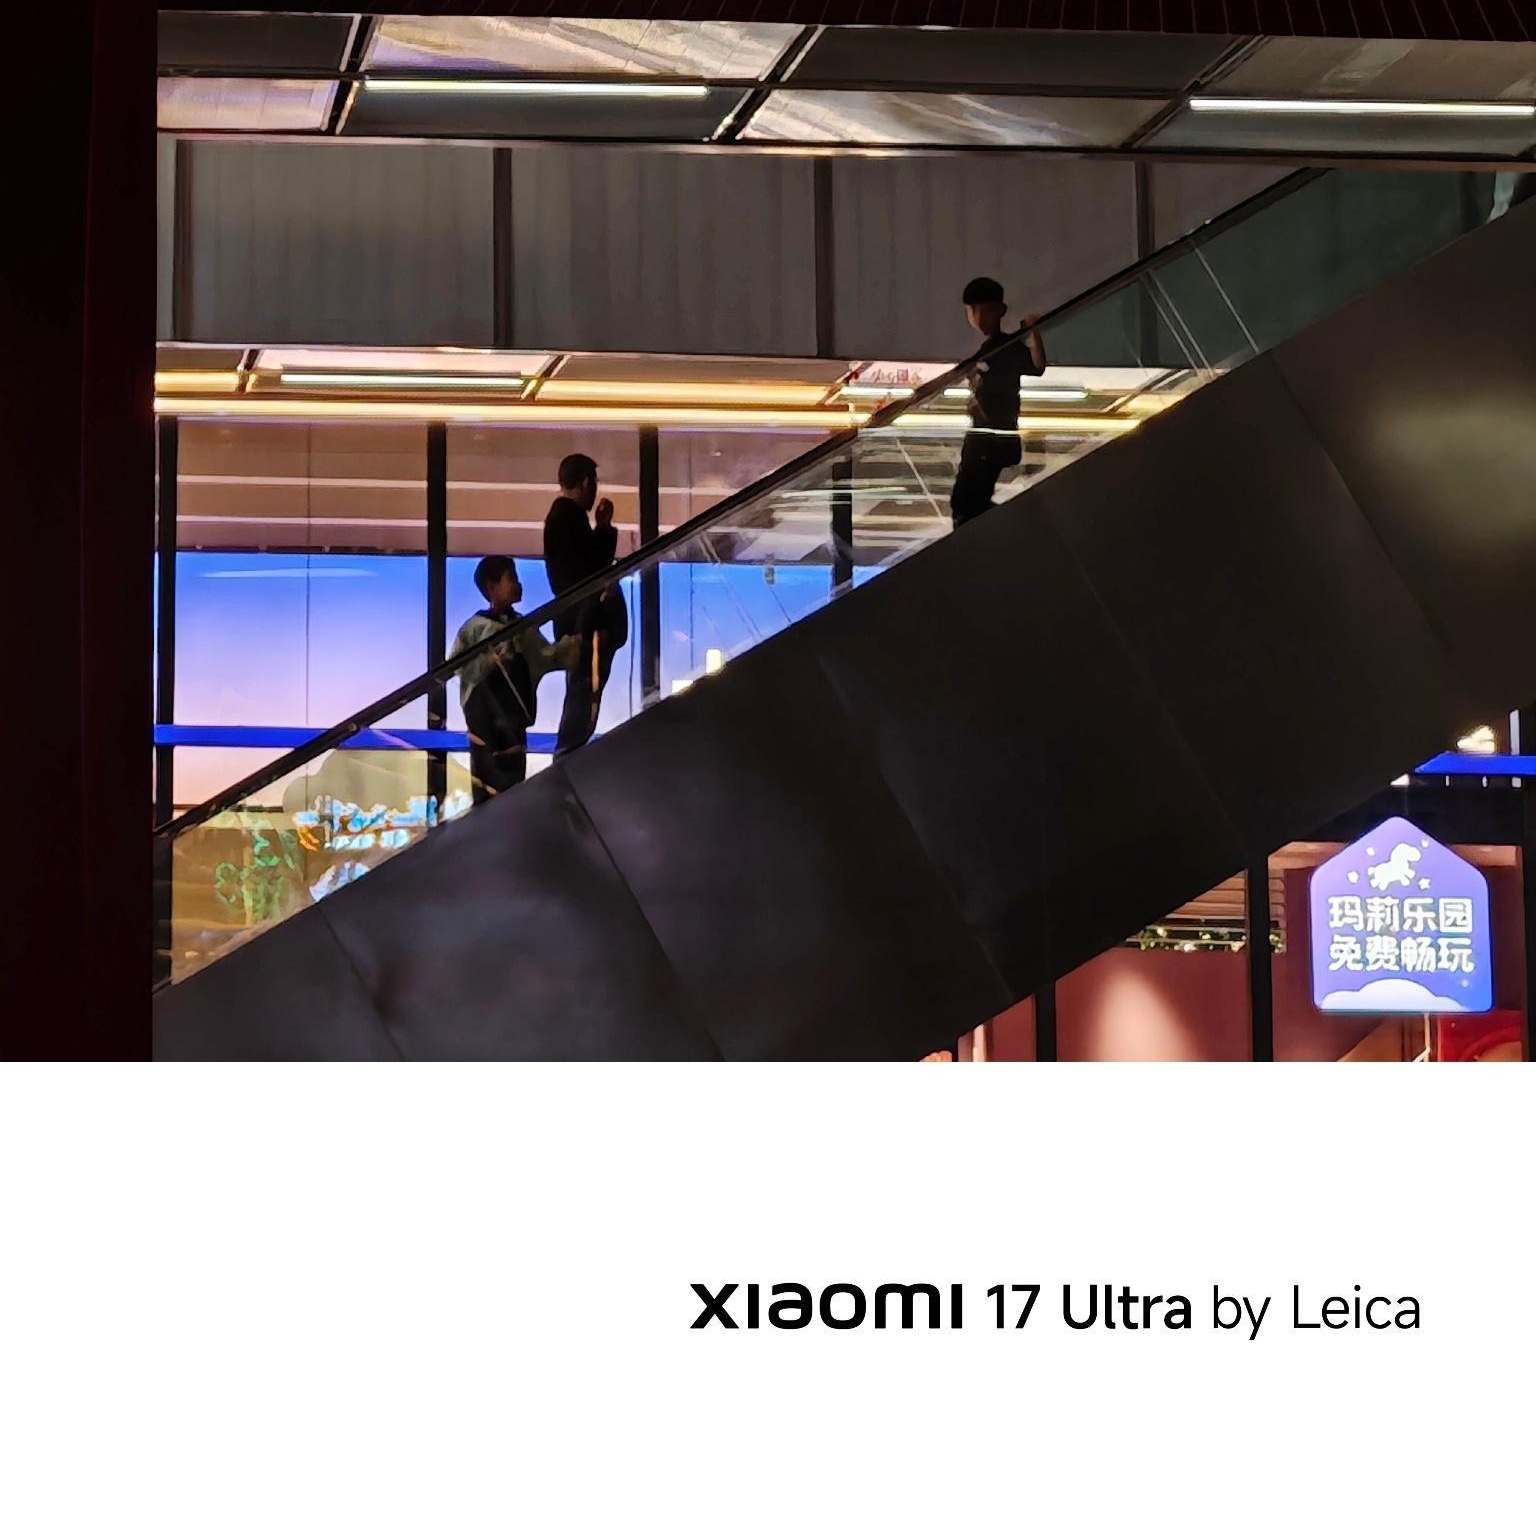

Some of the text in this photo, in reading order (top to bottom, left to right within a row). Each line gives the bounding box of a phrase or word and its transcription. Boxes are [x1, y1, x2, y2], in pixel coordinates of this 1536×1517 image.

[1327, 894, 1473, 934] 玛莉乐园
[1327, 934, 1475, 973] 免费畅玩
